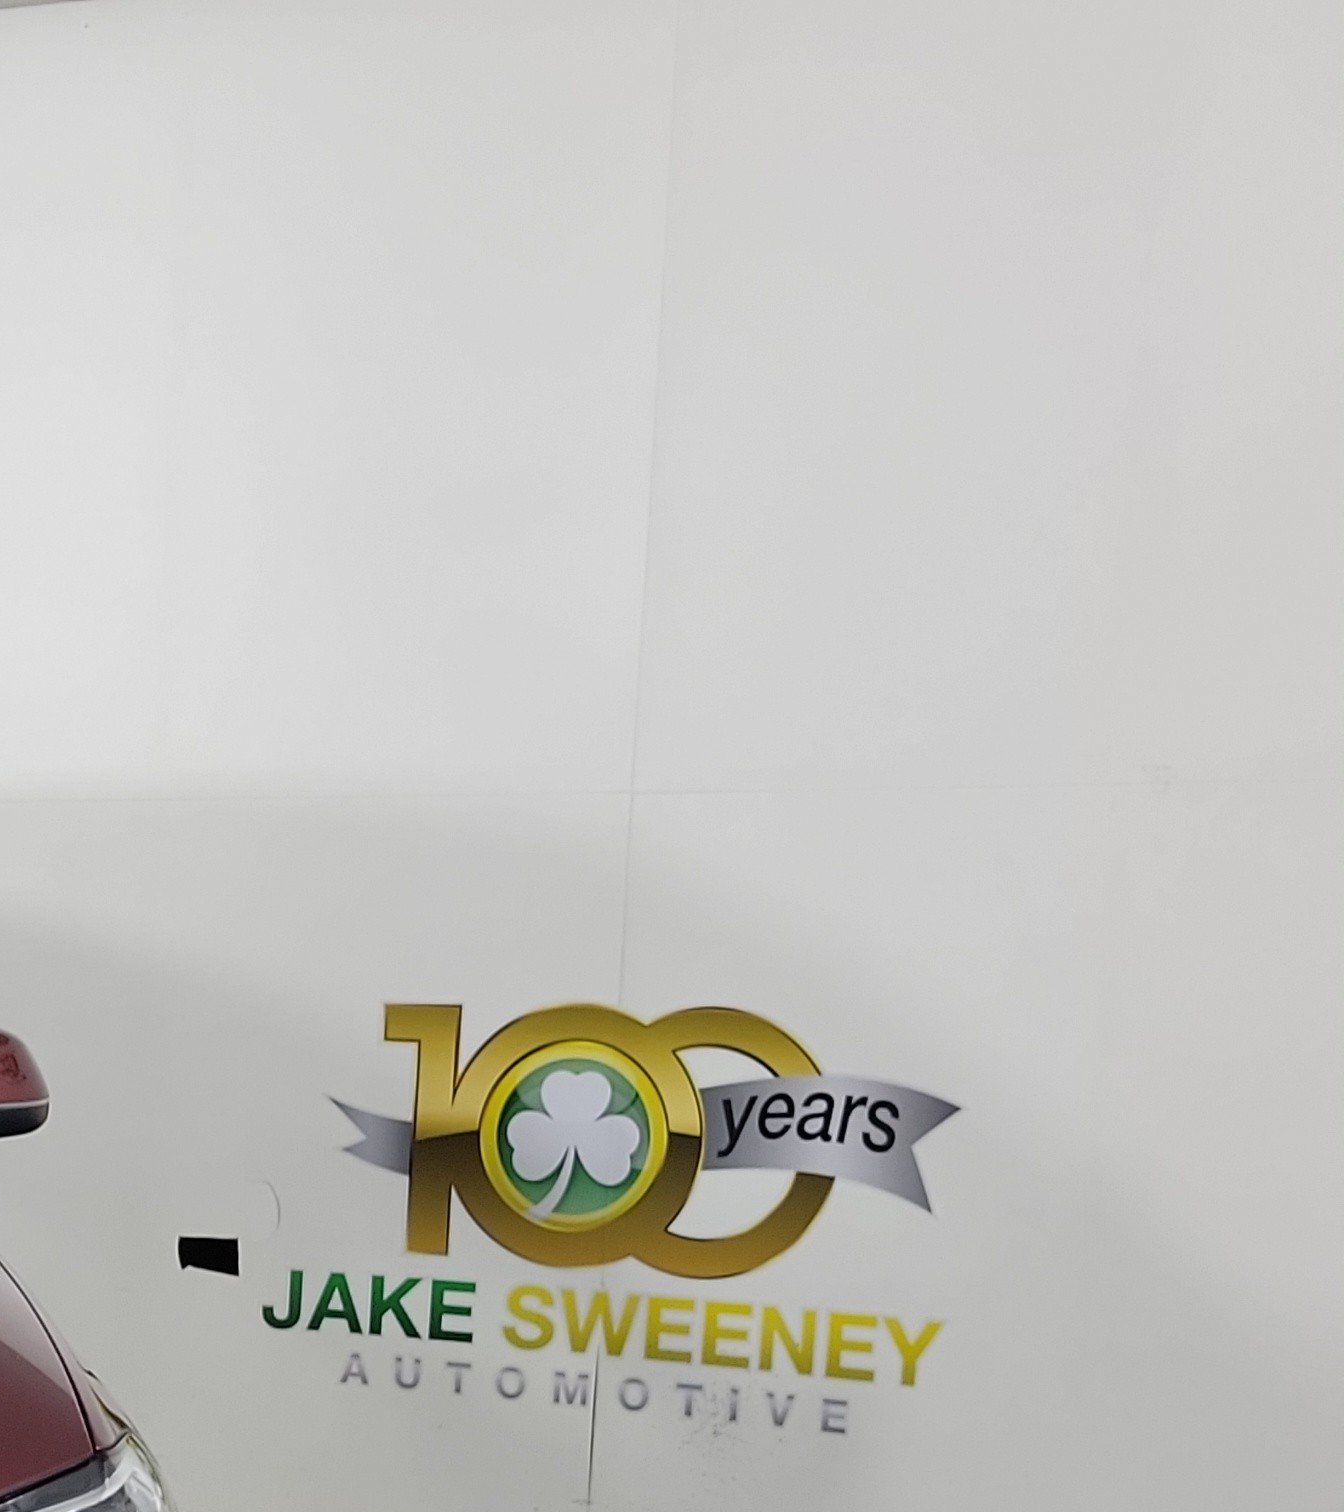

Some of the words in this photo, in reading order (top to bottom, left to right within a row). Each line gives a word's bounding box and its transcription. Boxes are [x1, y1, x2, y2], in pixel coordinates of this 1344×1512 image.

[383, 1002, 836, 1279] 100
[716, 1091, 900, 1157] years
[262, 1269, 477, 1344] JAKE
[502, 1285, 944, 1387] SWEENEY
[340, 1352, 850, 1435] AUTOMOTIVE
